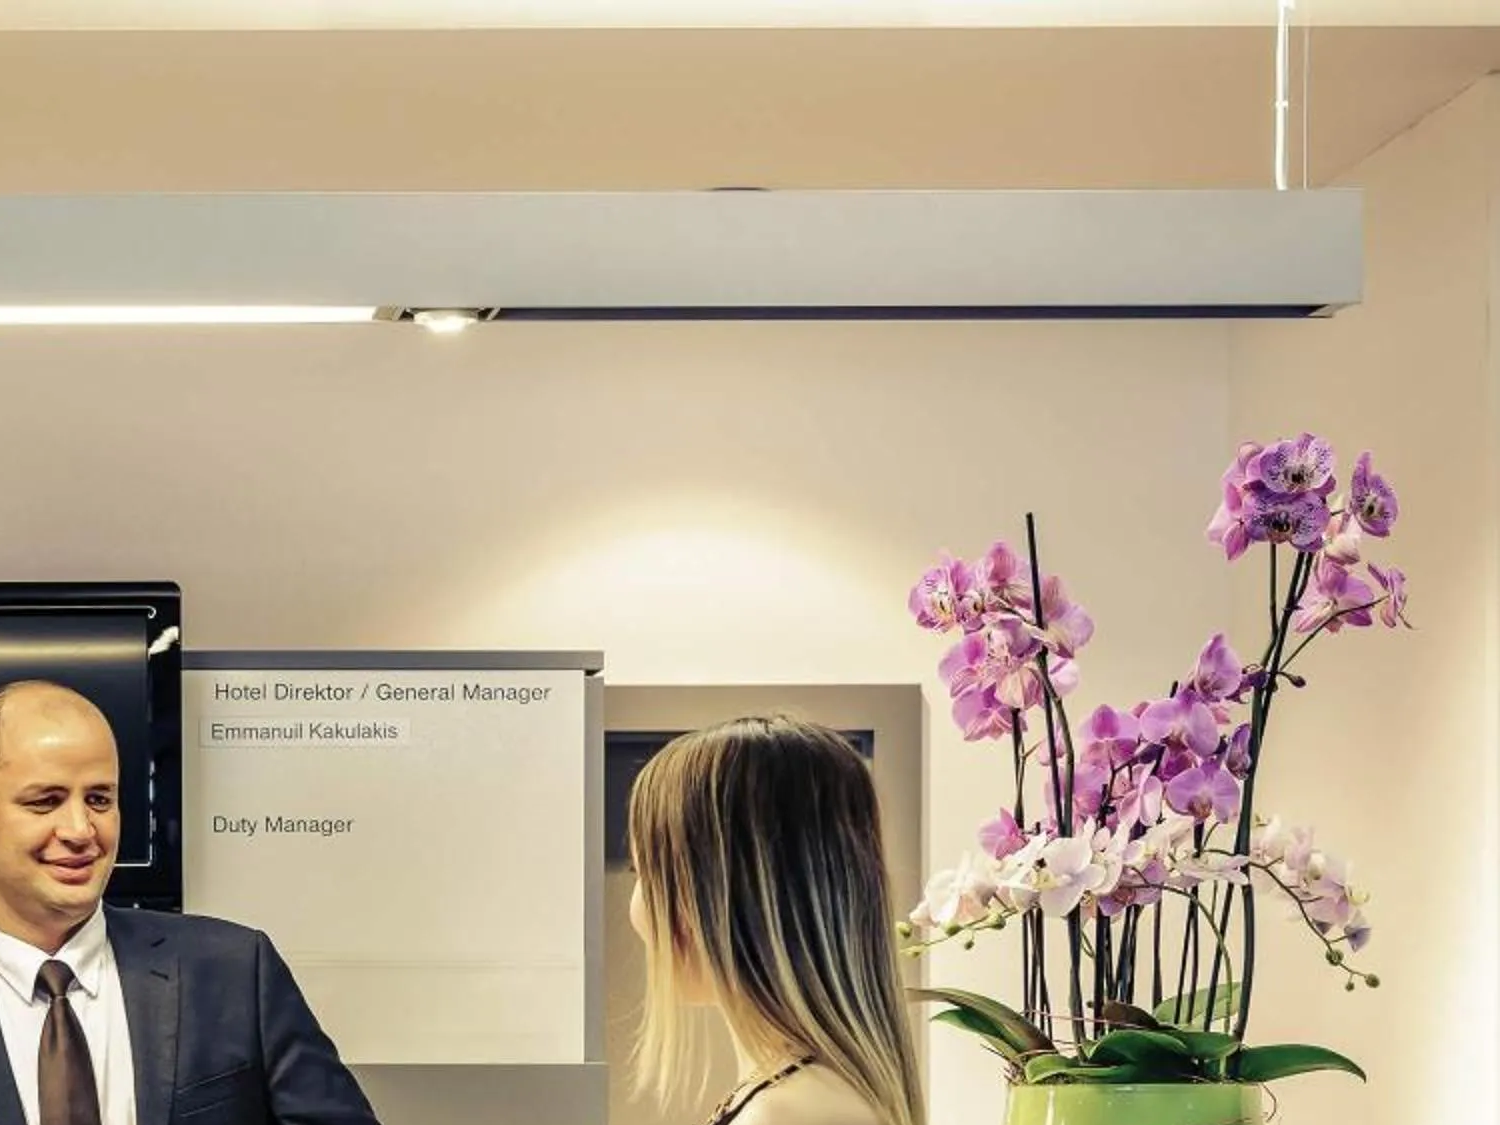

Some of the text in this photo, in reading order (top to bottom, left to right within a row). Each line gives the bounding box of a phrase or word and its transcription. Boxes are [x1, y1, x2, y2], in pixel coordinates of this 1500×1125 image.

[214, 683, 552, 705] Hotel Direktor / General Manager
[211, 722, 399, 741] Emmanuil Kakulakis
[213, 816, 355, 837] Duty Manager
